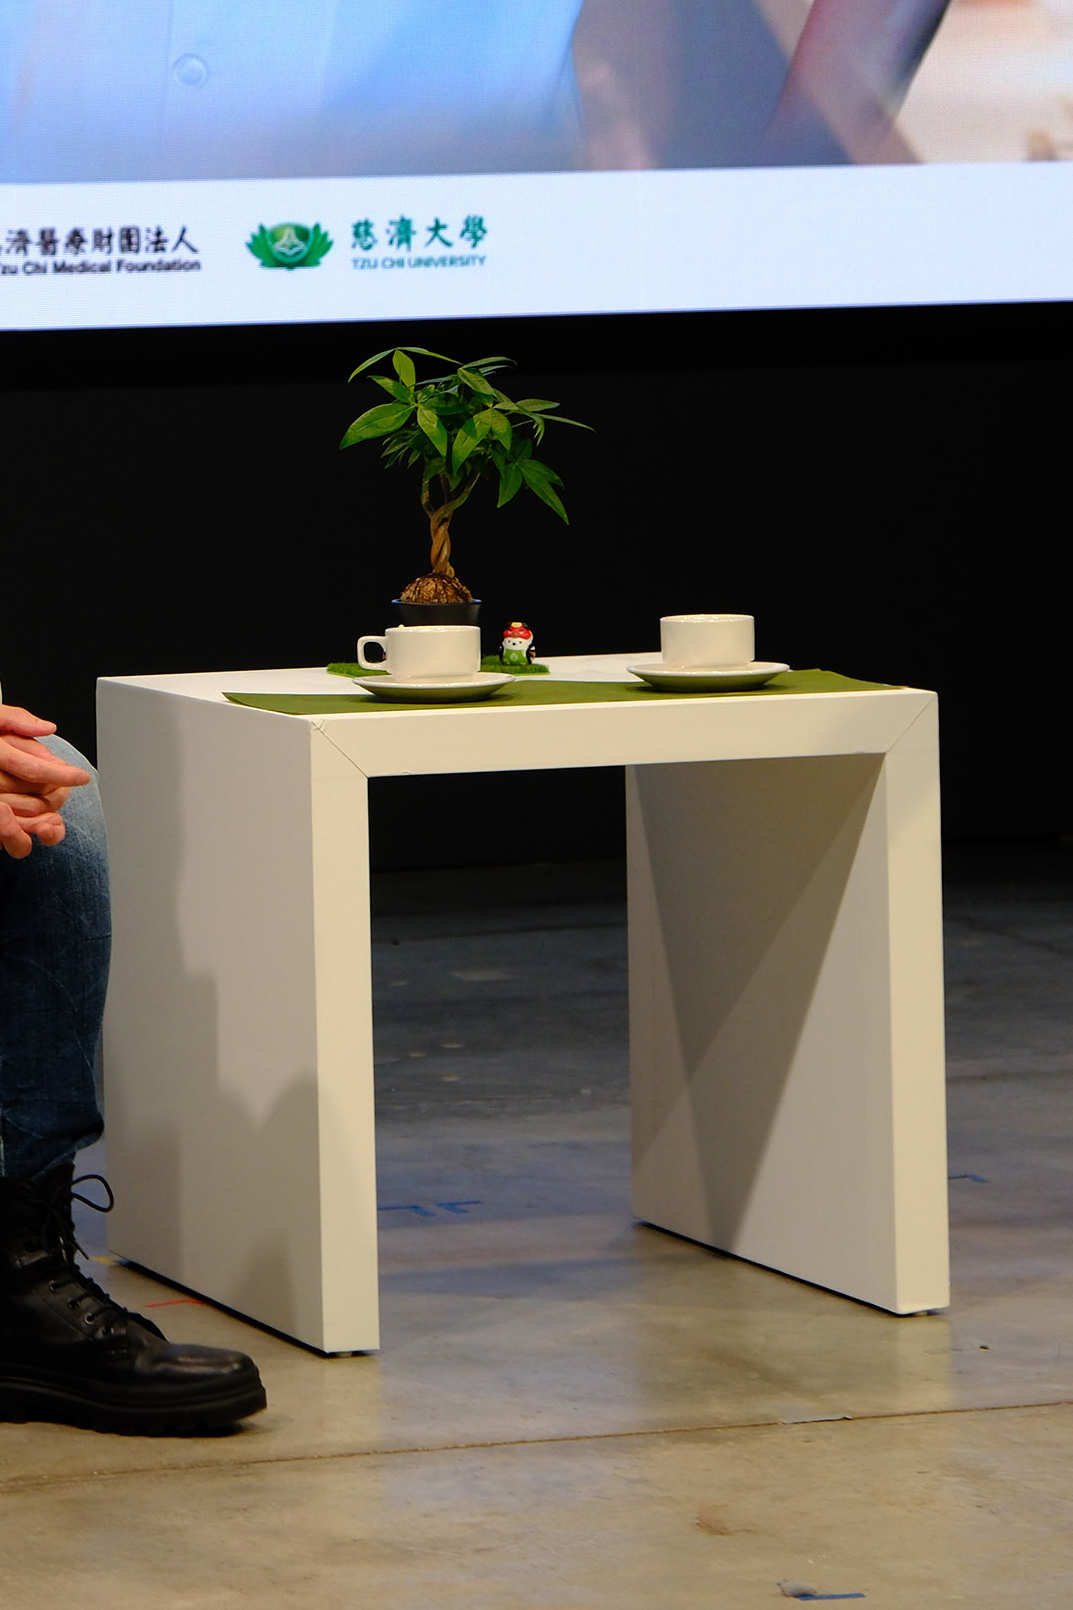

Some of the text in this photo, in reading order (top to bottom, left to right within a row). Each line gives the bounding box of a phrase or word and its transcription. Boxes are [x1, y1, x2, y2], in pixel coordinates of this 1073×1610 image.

[351, 215, 488, 251] 慈濟大學
[23, 261, 47, 274] Chi
[53, 260, 112, 273] Medical
[117, 258, 201, 272] Foundation
[352, 257, 378, 269] TZU
[408, 254, 487, 268] UNIVERSITY
